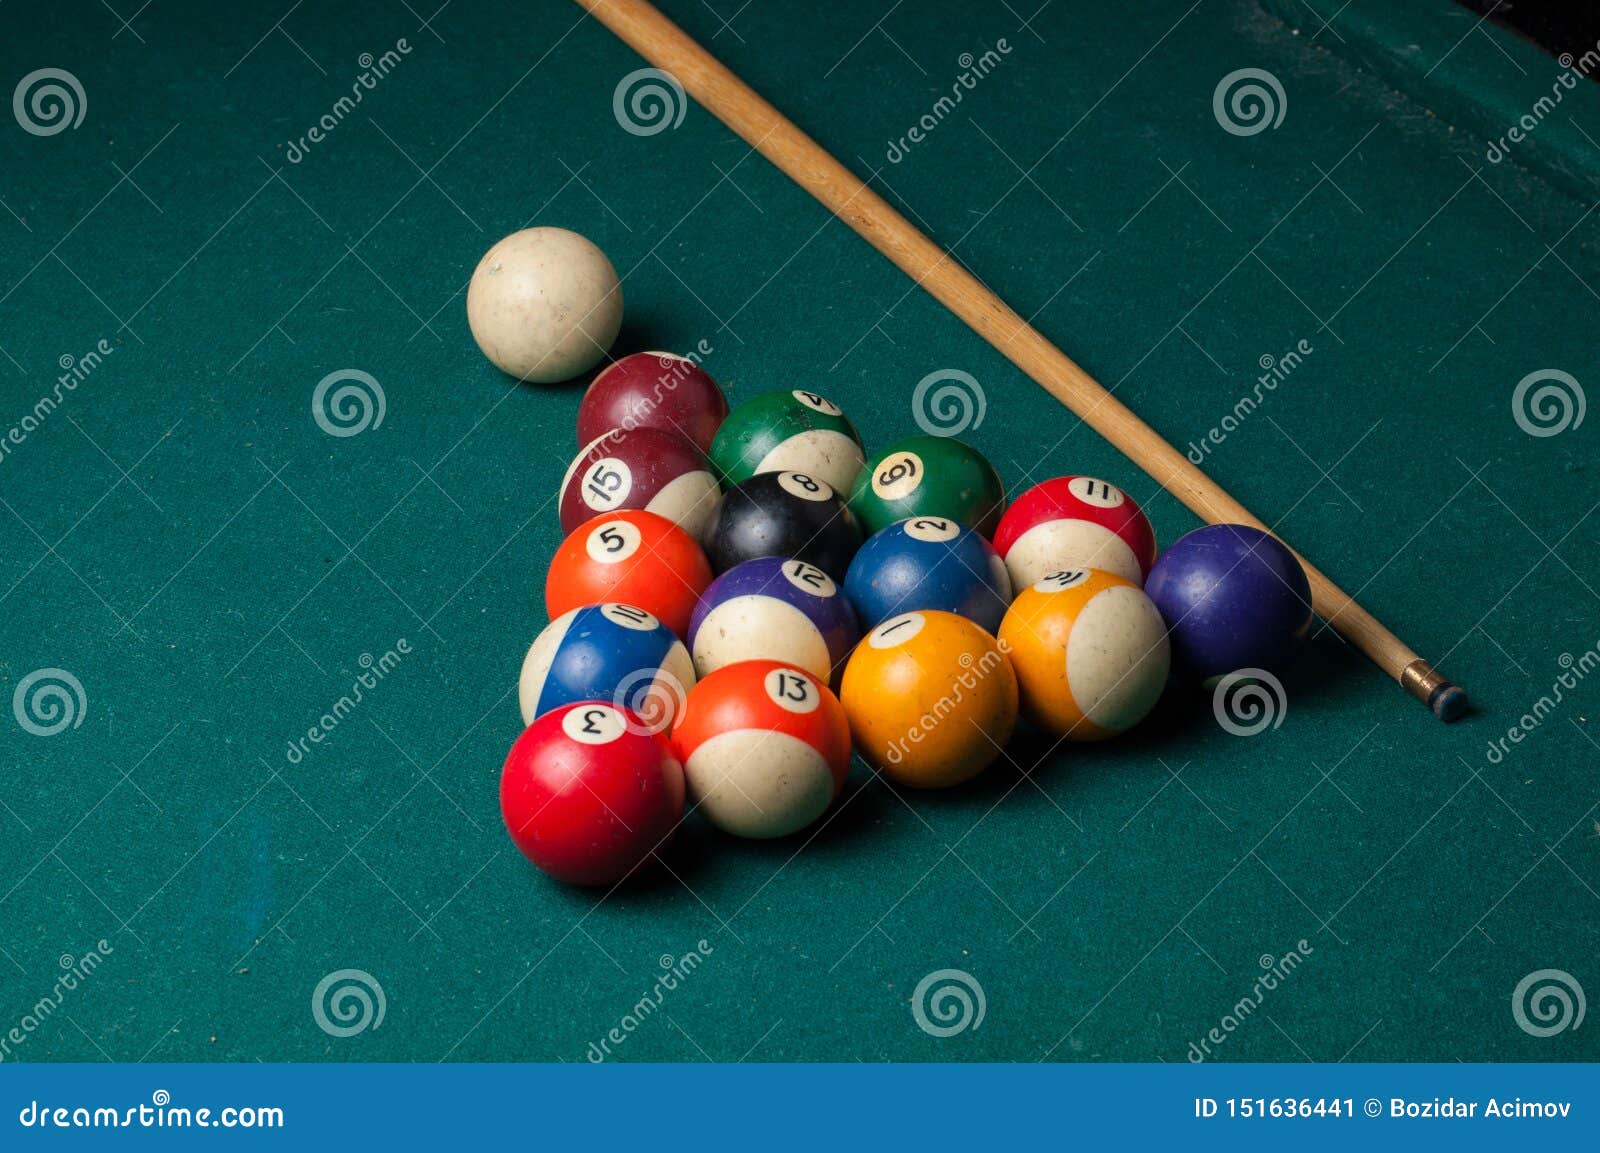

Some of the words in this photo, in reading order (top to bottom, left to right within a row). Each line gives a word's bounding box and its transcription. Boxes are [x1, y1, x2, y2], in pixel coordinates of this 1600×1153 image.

[588, 465, 622, 502] 15
[792, 474, 819, 492] 8
[1086, 480, 1109, 500] 11
[600, 527, 625, 553] 5
[793, 563, 826, 588] 12
[777, 673, 807, 702] 13
[582, 710, 606, 734] 3
